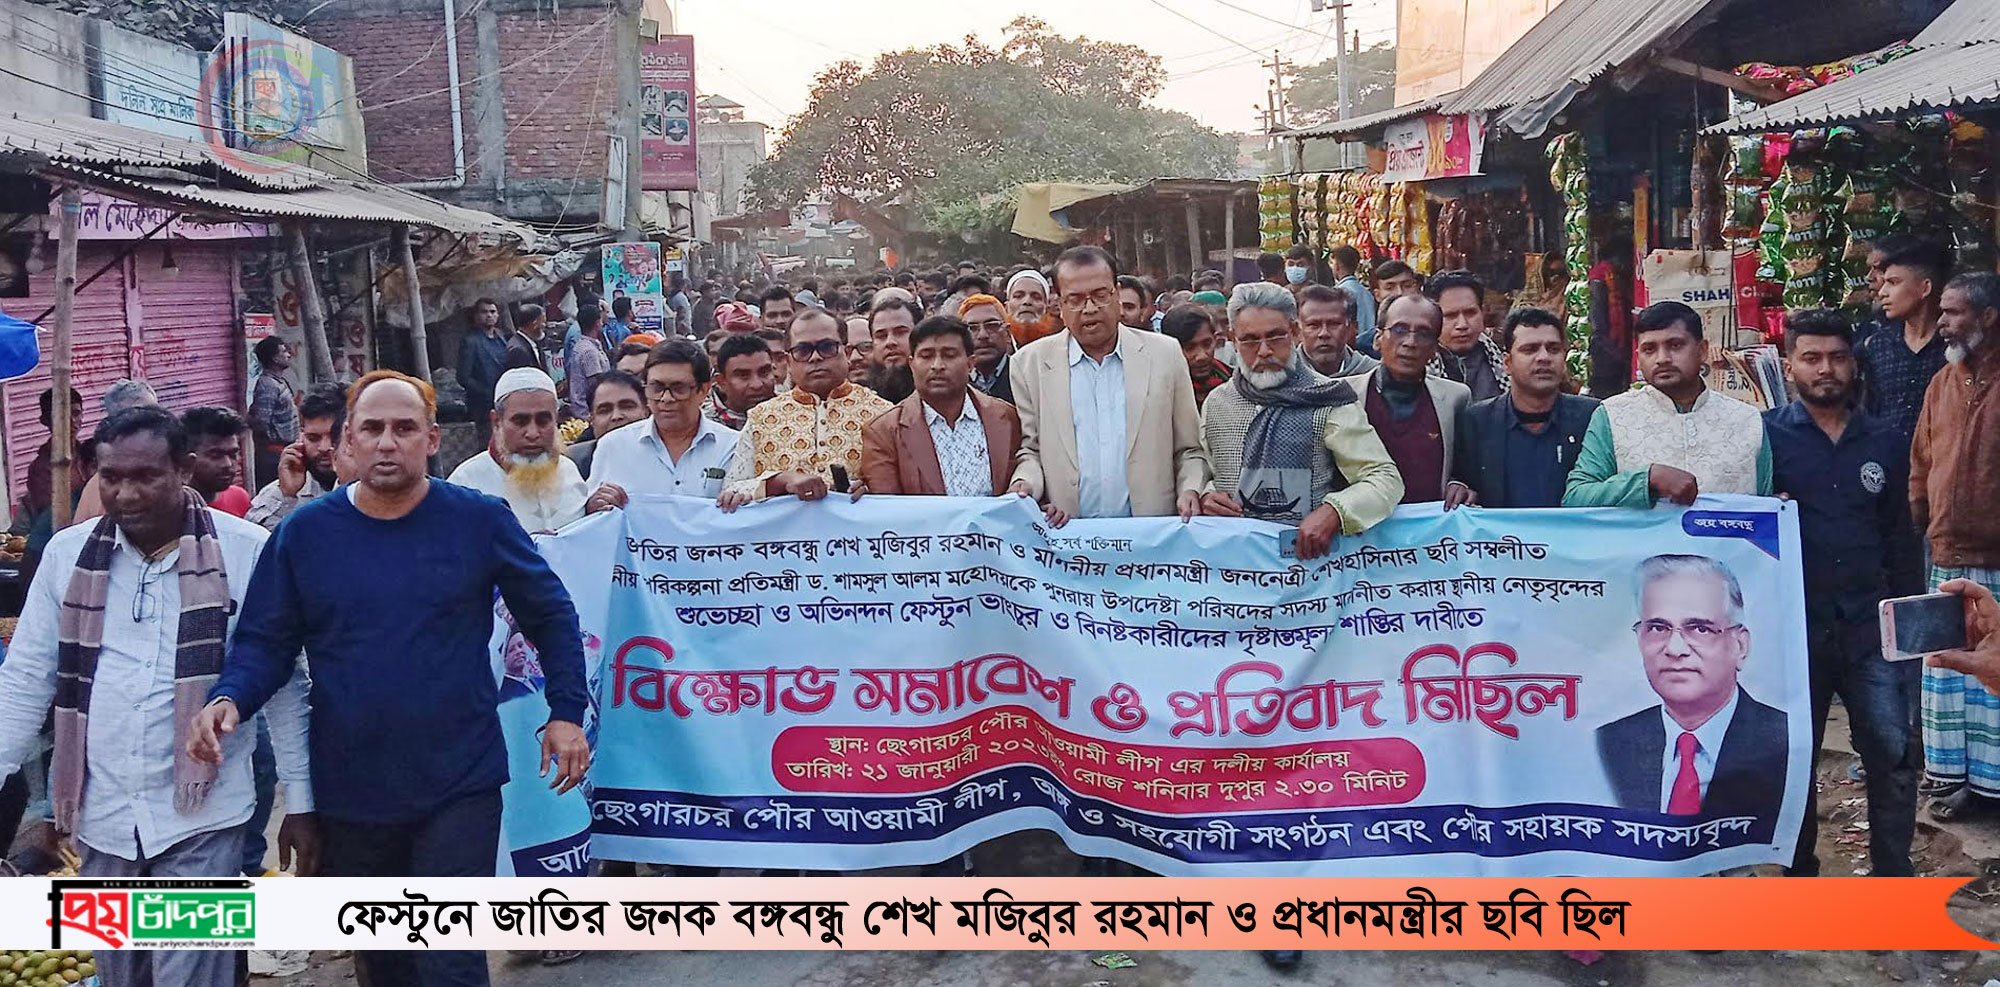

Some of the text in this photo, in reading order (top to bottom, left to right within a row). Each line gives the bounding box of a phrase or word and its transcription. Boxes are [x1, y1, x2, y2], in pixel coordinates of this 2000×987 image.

[1682, 288, 1731, 302] SHAH
[625, 536, 679, 563] জতির
[686, 543, 746, 563] জনক
[751, 540, 820, 564] বঙ্গবন্ধু
[826, 536, 862, 557] শেখ
[867, 530, 932, 560] মুজিবুর
[938, 532, 1004, 556] রহমান
[1010, 543, 1026, 559] ও
[1115, 560, 1213, 584] প্রধানমন্ত্রী
[1219, 564, 1310, 589] জননেত্রী
[1423, 537, 1459, 564] ছবি
[1463, 535, 1550, 561] সম্বলীত
[645, 573, 722, 596] রিকল্পনা
[728, 569, 802, 593] প্রতিমন্ত্রী
[805, 574, 828, 591] ড.
[834, 571, 888, 594] শামসুল
[892, 571, 942, 590] আলম
[947, 565, 1037, 593] মহোদয়কে
[1042, 582, 1096, 609] পুনরায়
[1101, 588, 1182, 616] উপদেষ্টা
[1187, 596, 1275, 620] পরিষদের
[1279, 596, 1329, 618] সদস্য
[1396, 579, 1447, 600] করায়
[1449, 571, 1498, 599] স্থানীয়
[1503, 576, 1607, 603] নেতৃবৃন্দের
[675, 602, 765, 628] শুভেচ্ছা
[771, 604, 791, 623] ও
[798, 596, 895, 625] অভিনন্দন
[900, 593, 974, 629] ফেস্টুন
[1050, 611, 1070, 630] ও
[1075, 611, 1231, 648] বিনষ্টকারীদের
[1235, 624, 1334, 657] দৃষ্টান্তমূল
[1339, 607, 1406, 637] শাস্তির
[1410, 600, 1487, 632] দাবীতে
[609, 635, 1583, 741] বিক্ষোভ সমাবেশ ও প্রতিবাদ মিছিল
[784, 757, 853, 780] তারিখ:
[861, 763, 889, 782] ২১
[896, 743, 981, 780] জানুয়ারী
[1073, 767, 1127, 794] রোজ
[1132, 776, 1211, 801] শনিবার
[1217, 779, 1266, 802] দুপুর
[1273, 776, 1334, 799] ২.৩০
[1340, 769, 1411, 793] মিনিট
[824, 711, 1353, 776] স্থান: ছেংগারচর পৌর আওয়ামী লীগ এর দলীয় কার্যালয়
[592, 798, 735, 829] ছেংগারচর
[743, 799, 816, 833] পৌর
[822, 797, 949, 833] আওয়ামী
[1079, 804, 1105, 826] ও
[1113, 813, 1241, 852] সহযোগী
[1246, 811, 1354, 849] সংগঠন
[1362, 817, 1433, 844] এবং
[1442, 807, 1496, 845] পৌর
[1501, 812, 1606, 842] সহায়ক
[1611, 814, 1759, 850] সদস্যবৃন্দ
